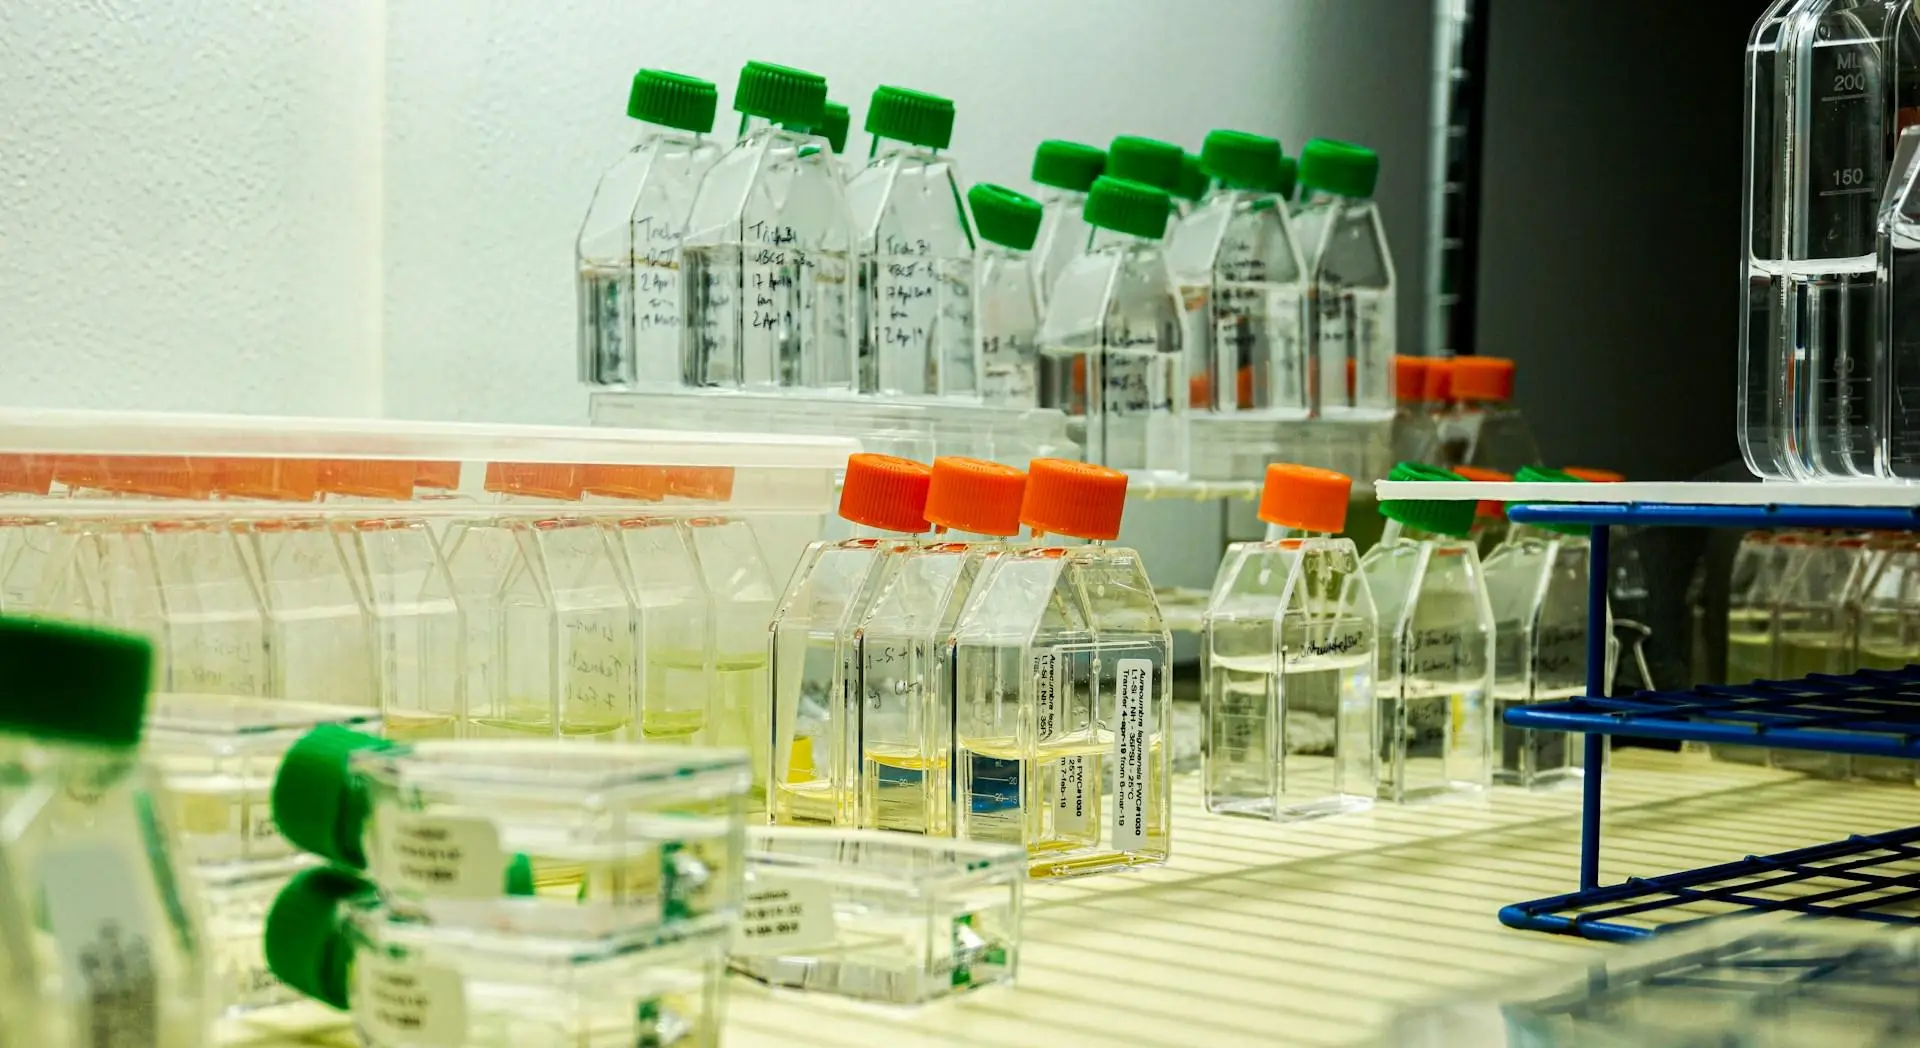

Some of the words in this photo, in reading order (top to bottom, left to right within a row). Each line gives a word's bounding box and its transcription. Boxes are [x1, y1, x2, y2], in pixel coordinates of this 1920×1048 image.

[1833, 73, 1865, 92] 200
[1832, 168, 1864, 186] 150
[1122, 669, 1130, 713] Transfer
[1120, 712, 1128, 754] 4-apr-19
[1135, 782, 1143, 837] FWC#1030
